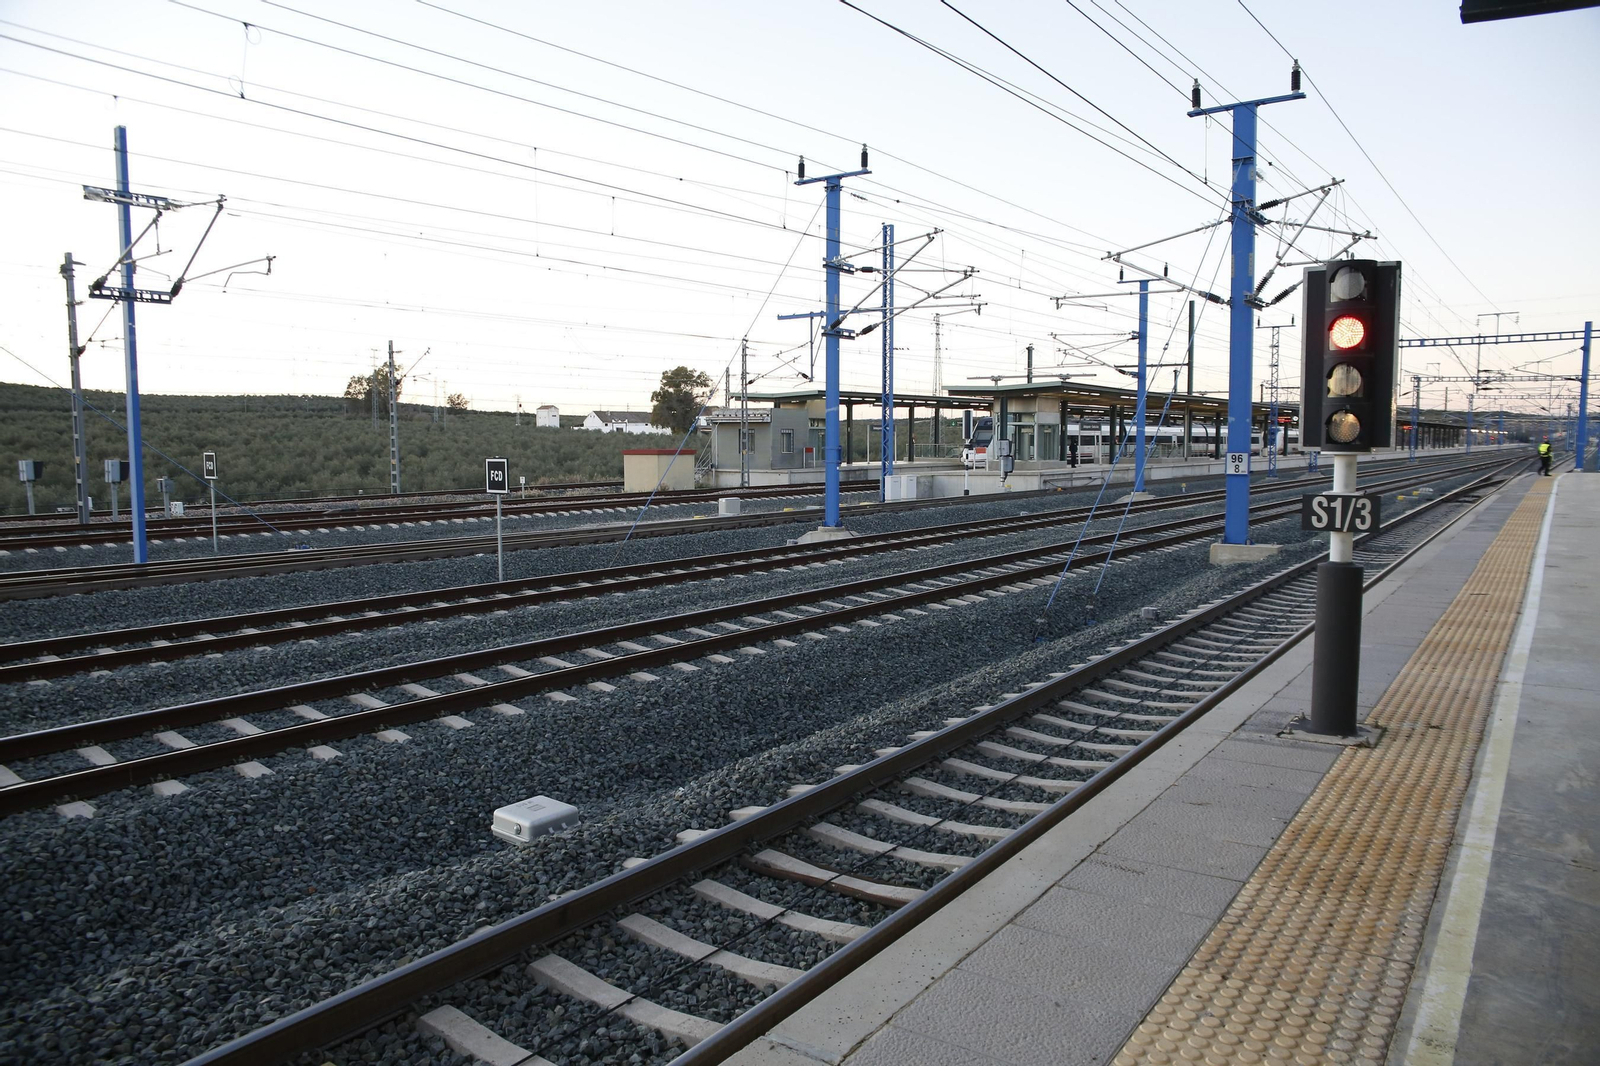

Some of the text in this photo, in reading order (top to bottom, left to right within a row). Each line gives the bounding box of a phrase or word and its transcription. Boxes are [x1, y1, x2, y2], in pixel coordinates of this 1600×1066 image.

[1231, 454, 1244, 464] 96
[1234, 464, 1240, 473] 8
[490, 470, 503, 481] FCD
[1311, 495, 1372, 532] S1/3
